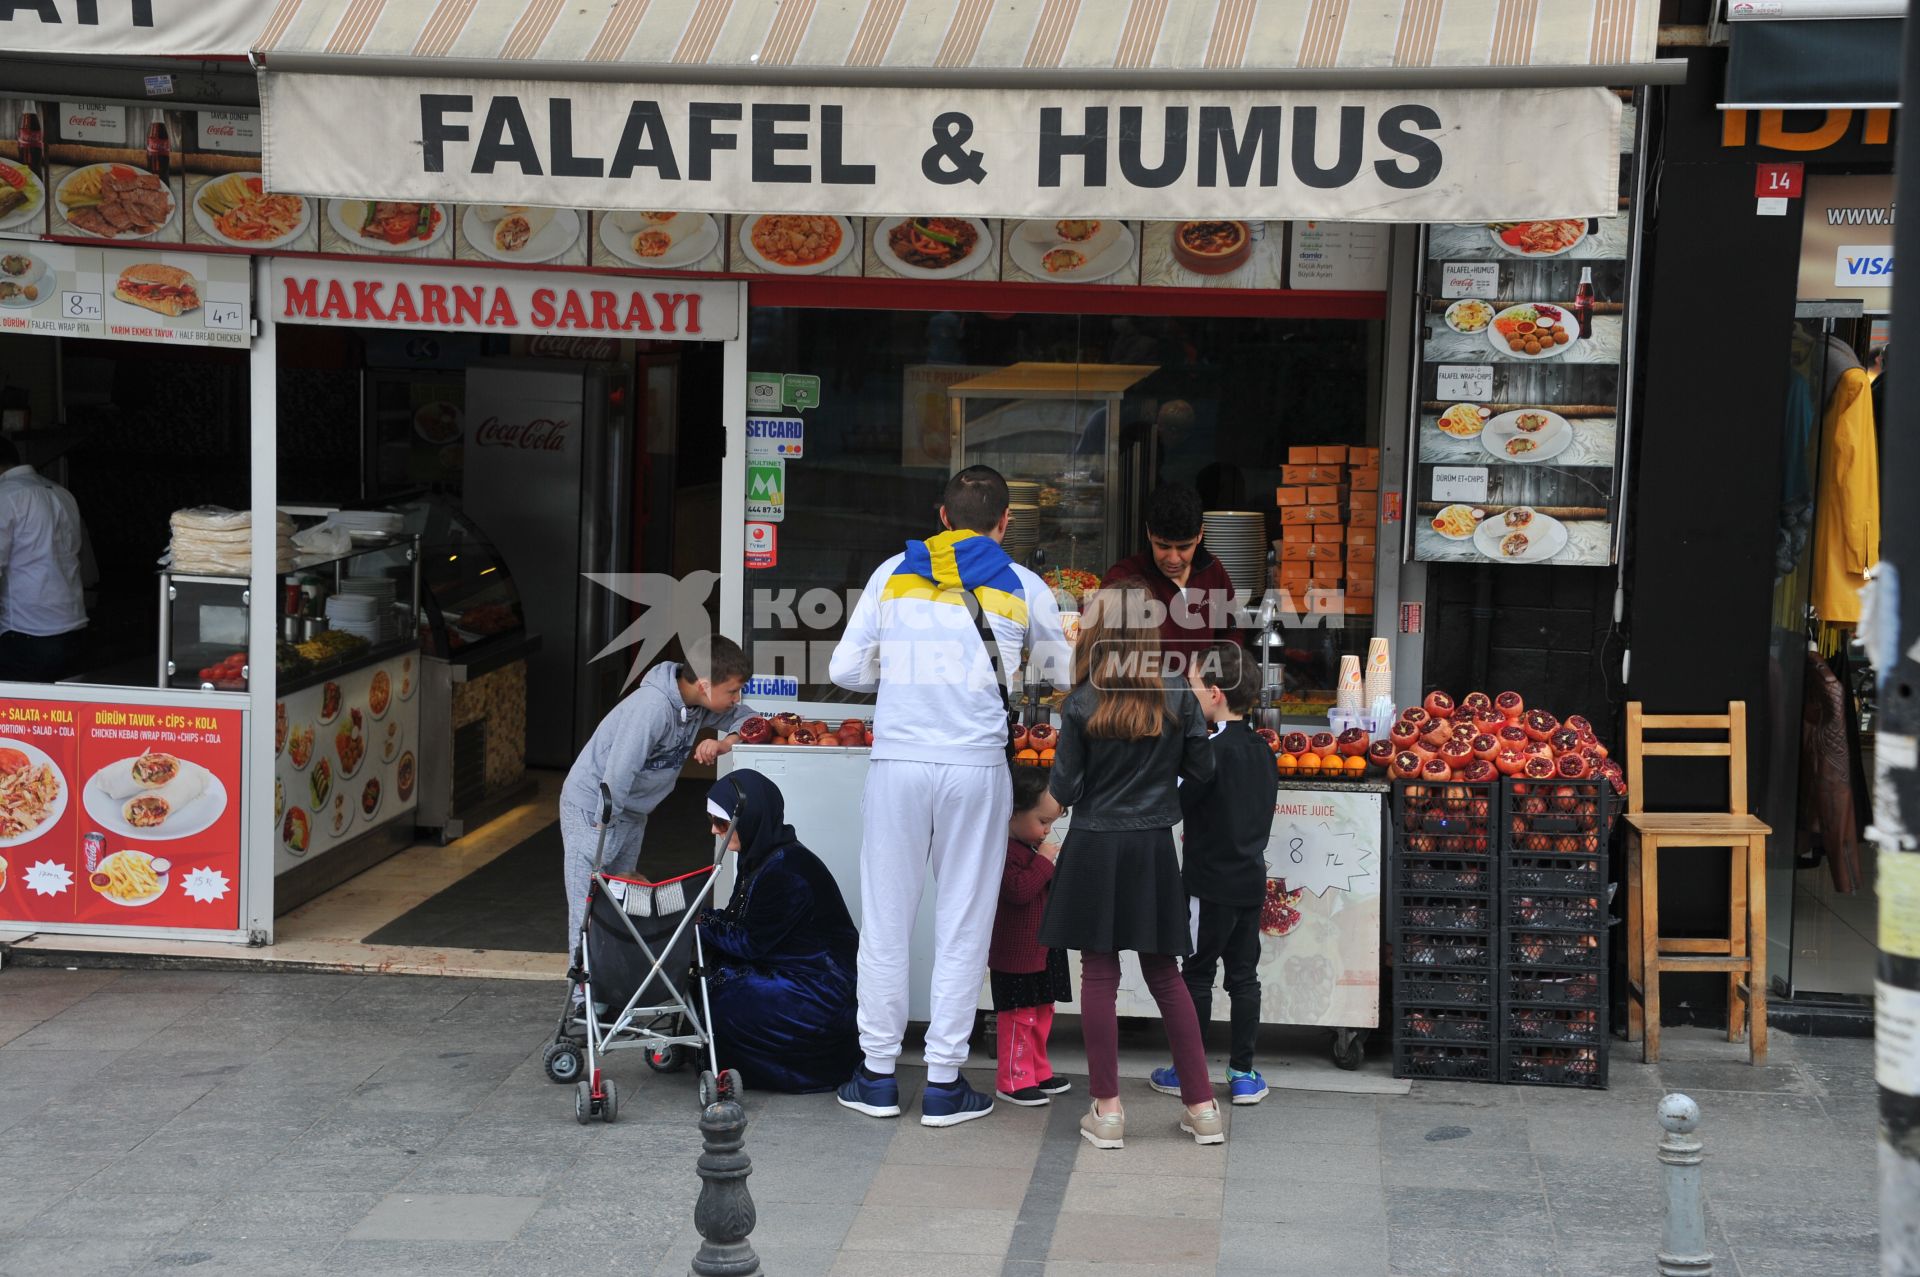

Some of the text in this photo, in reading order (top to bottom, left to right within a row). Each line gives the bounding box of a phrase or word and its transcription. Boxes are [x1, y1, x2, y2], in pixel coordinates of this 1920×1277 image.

[420, 94, 1443, 190] FALAFEL & HUMUS
[1769, 172, 1790, 190] 14
[1844, 257, 1895, 275] VISA
[70, 295, 84, 316] 8
[283, 278, 703, 334] MAKARNA SARAYI
[212, 309, 222, 324] 4
[31, 321, 57, 331] FALAFEL
[58, 322, 76, 332] WRAP
[132, 327, 154, 337] EKMEK
[179, 331, 194, 340] HALF
[195, 331, 215, 342] BREAD
[216, 333, 242, 343] CHICKEN
[475, 416, 569, 451] Coca-Cola
[746, 420, 803, 439] SETCARD
[742, 678, 797, 696] SETCARD
[9, 707, 40, 721] SALATA
[50, 709, 73, 723] KOLA
[95, 710, 126, 726] DÜRÜM
[128, 713, 155, 727] TAVUK
[195, 716, 218, 730] KOLA
[32, 725, 53, 736] SALAD
[59, 726, 75, 737] COLA
[91, 728, 118, 739] CHICKEN
[118, 729, 139, 740] KEBAB
[139, 730, 160, 742] (WRAP
[204, 732, 221, 744] COLA
[1309, 804, 1335, 817] JUICE
[1290, 837, 1304, 864] 8
